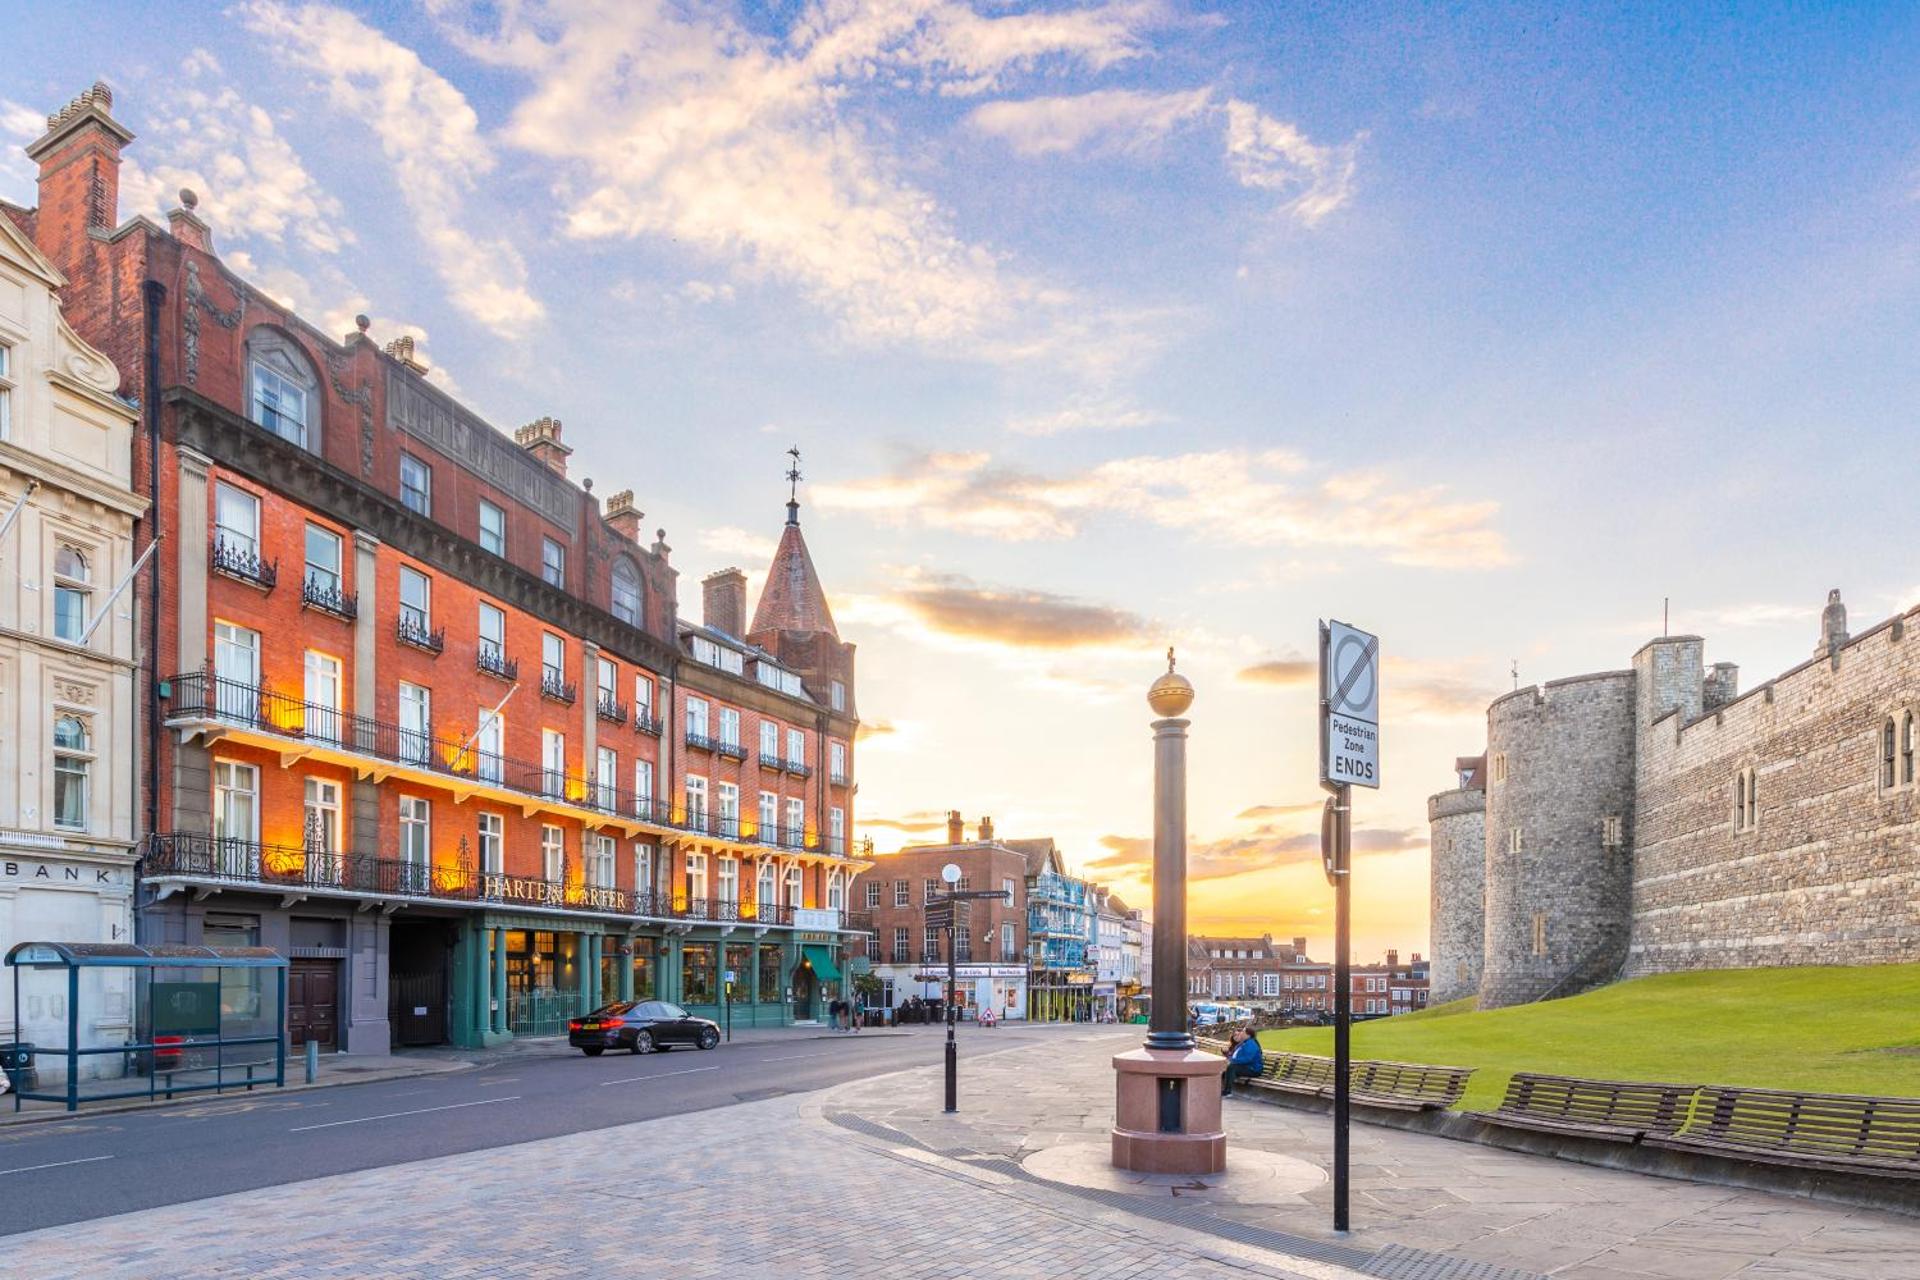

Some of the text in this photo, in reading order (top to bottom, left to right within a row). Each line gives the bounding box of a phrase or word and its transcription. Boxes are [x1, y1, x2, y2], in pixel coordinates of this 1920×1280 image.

[1333, 719, 1376, 740] Pedestrian
[1344, 737, 1364, 754] Zone
[1335, 756, 1373, 779] ENDS
[5, 862, 110, 883] BANK
[485, 876, 546, 901] HARTE
